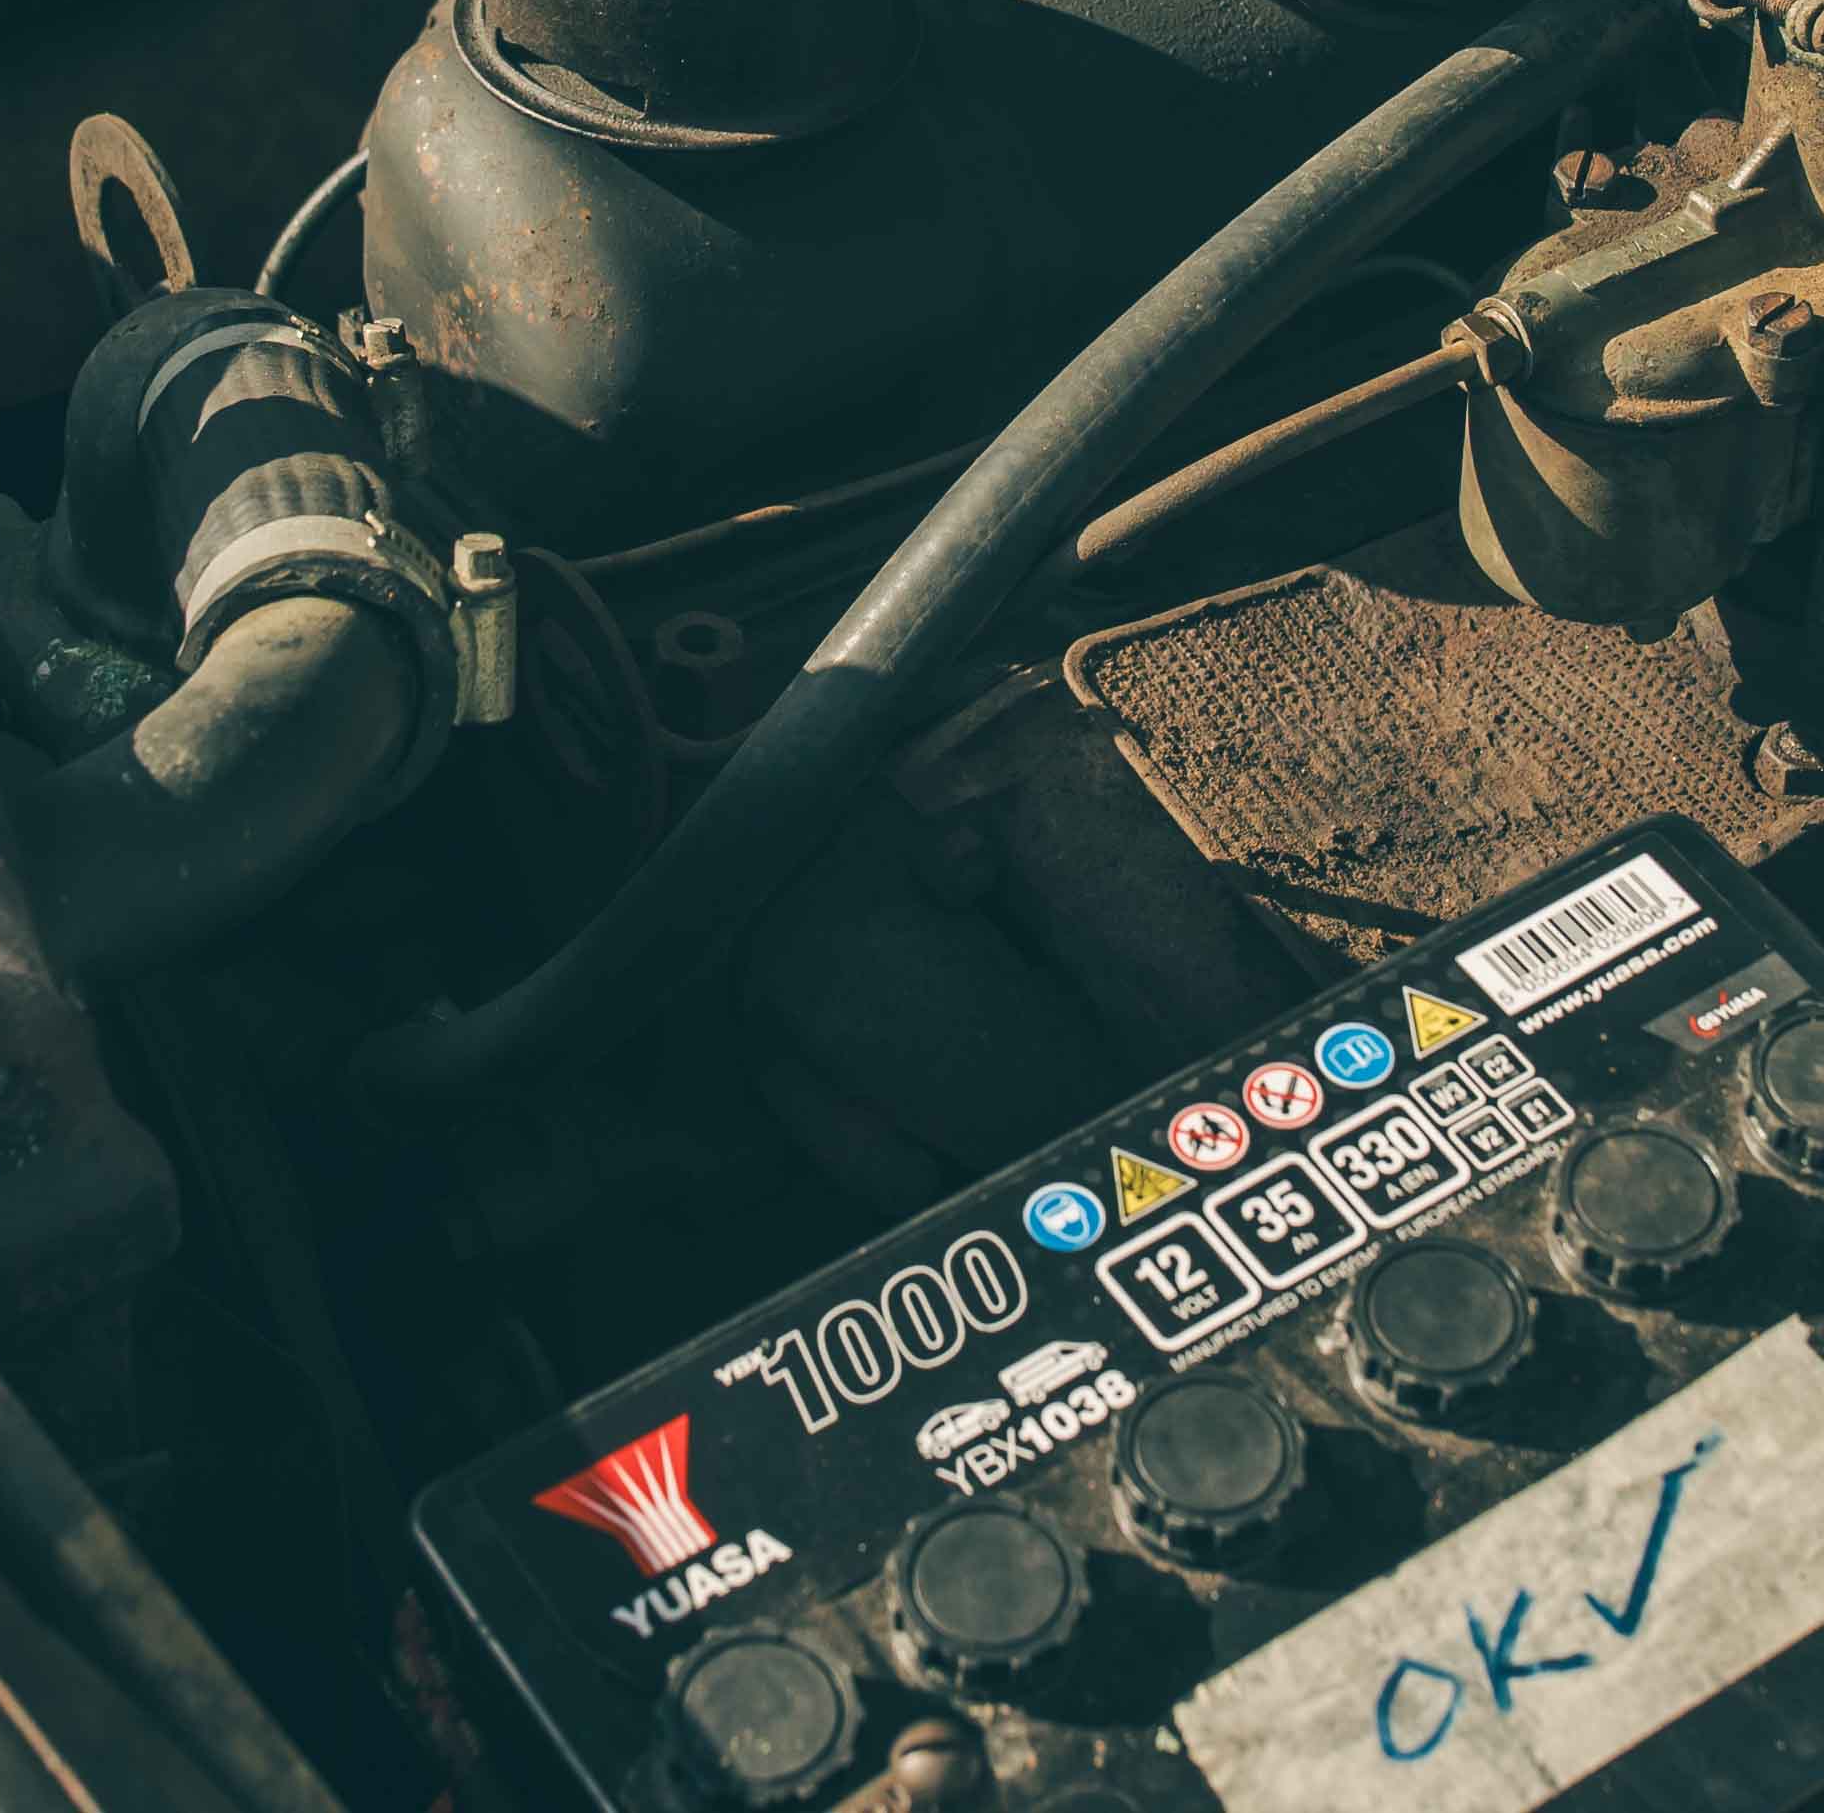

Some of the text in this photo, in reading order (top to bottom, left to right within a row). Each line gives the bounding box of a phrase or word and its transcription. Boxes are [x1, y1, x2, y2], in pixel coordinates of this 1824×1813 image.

[1517, 916, 1718, 1035] www.yuasa.com
[1713, 987, 1768, 1020] YUASA
[1332, 1115, 1432, 1190] 330
[1240, 1178, 1316, 1243] 35
[1134, 1243, 1209, 1302] 12
[1168, 1291, 1300, 1374] MANUFACTURED
[1295, 1278, 1323, 1300] TO
[1394, 1185, 1484, 1243] EUROPEAN
[1478, 1140, 1561, 1196] STANDARD
[1170, 1283, 1221, 1321] VOLT
[759, 1230, 1029, 1435] 1000
[935, 1369, 1138, 1497] YBX1038
[609, 1528, 794, 1638] YUASA
